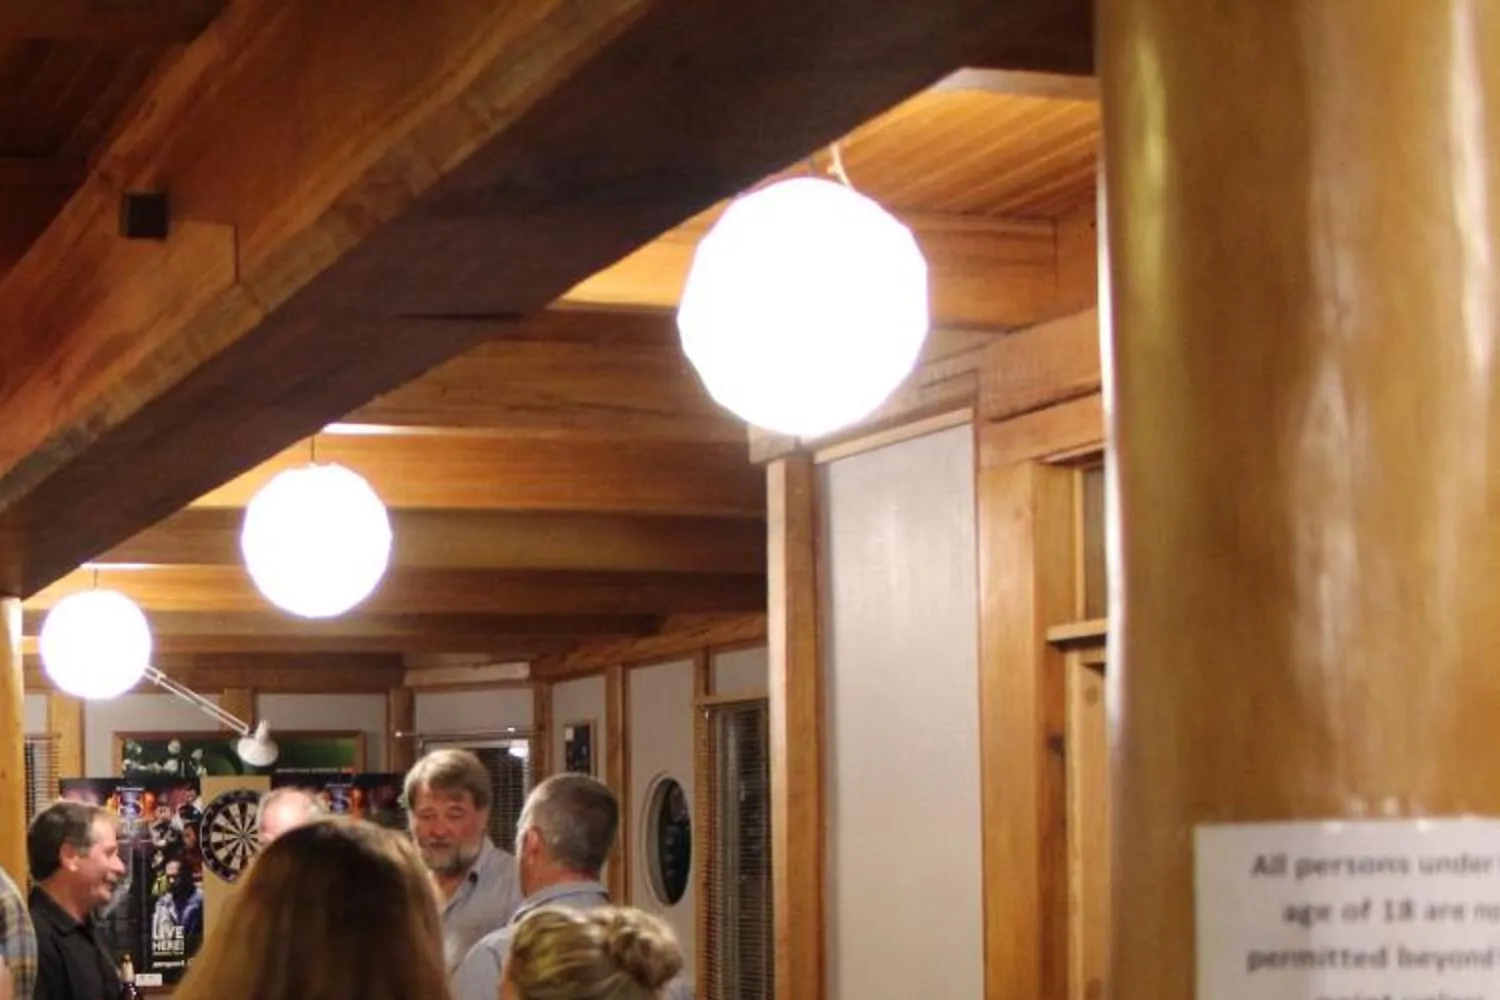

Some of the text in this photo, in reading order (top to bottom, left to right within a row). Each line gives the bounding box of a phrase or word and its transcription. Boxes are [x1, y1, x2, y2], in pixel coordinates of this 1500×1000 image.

[1251, 853, 1492, 882] All persons under
[1283, 904, 1331, 929] age
[1342, 897, 1371, 922] of
[1384, 898, 1416, 923] 18
[1424, 904, 1465, 922] are
[152, 925, 185, 940] LIVE
[1246, 942, 1493, 975] permitted beyond
